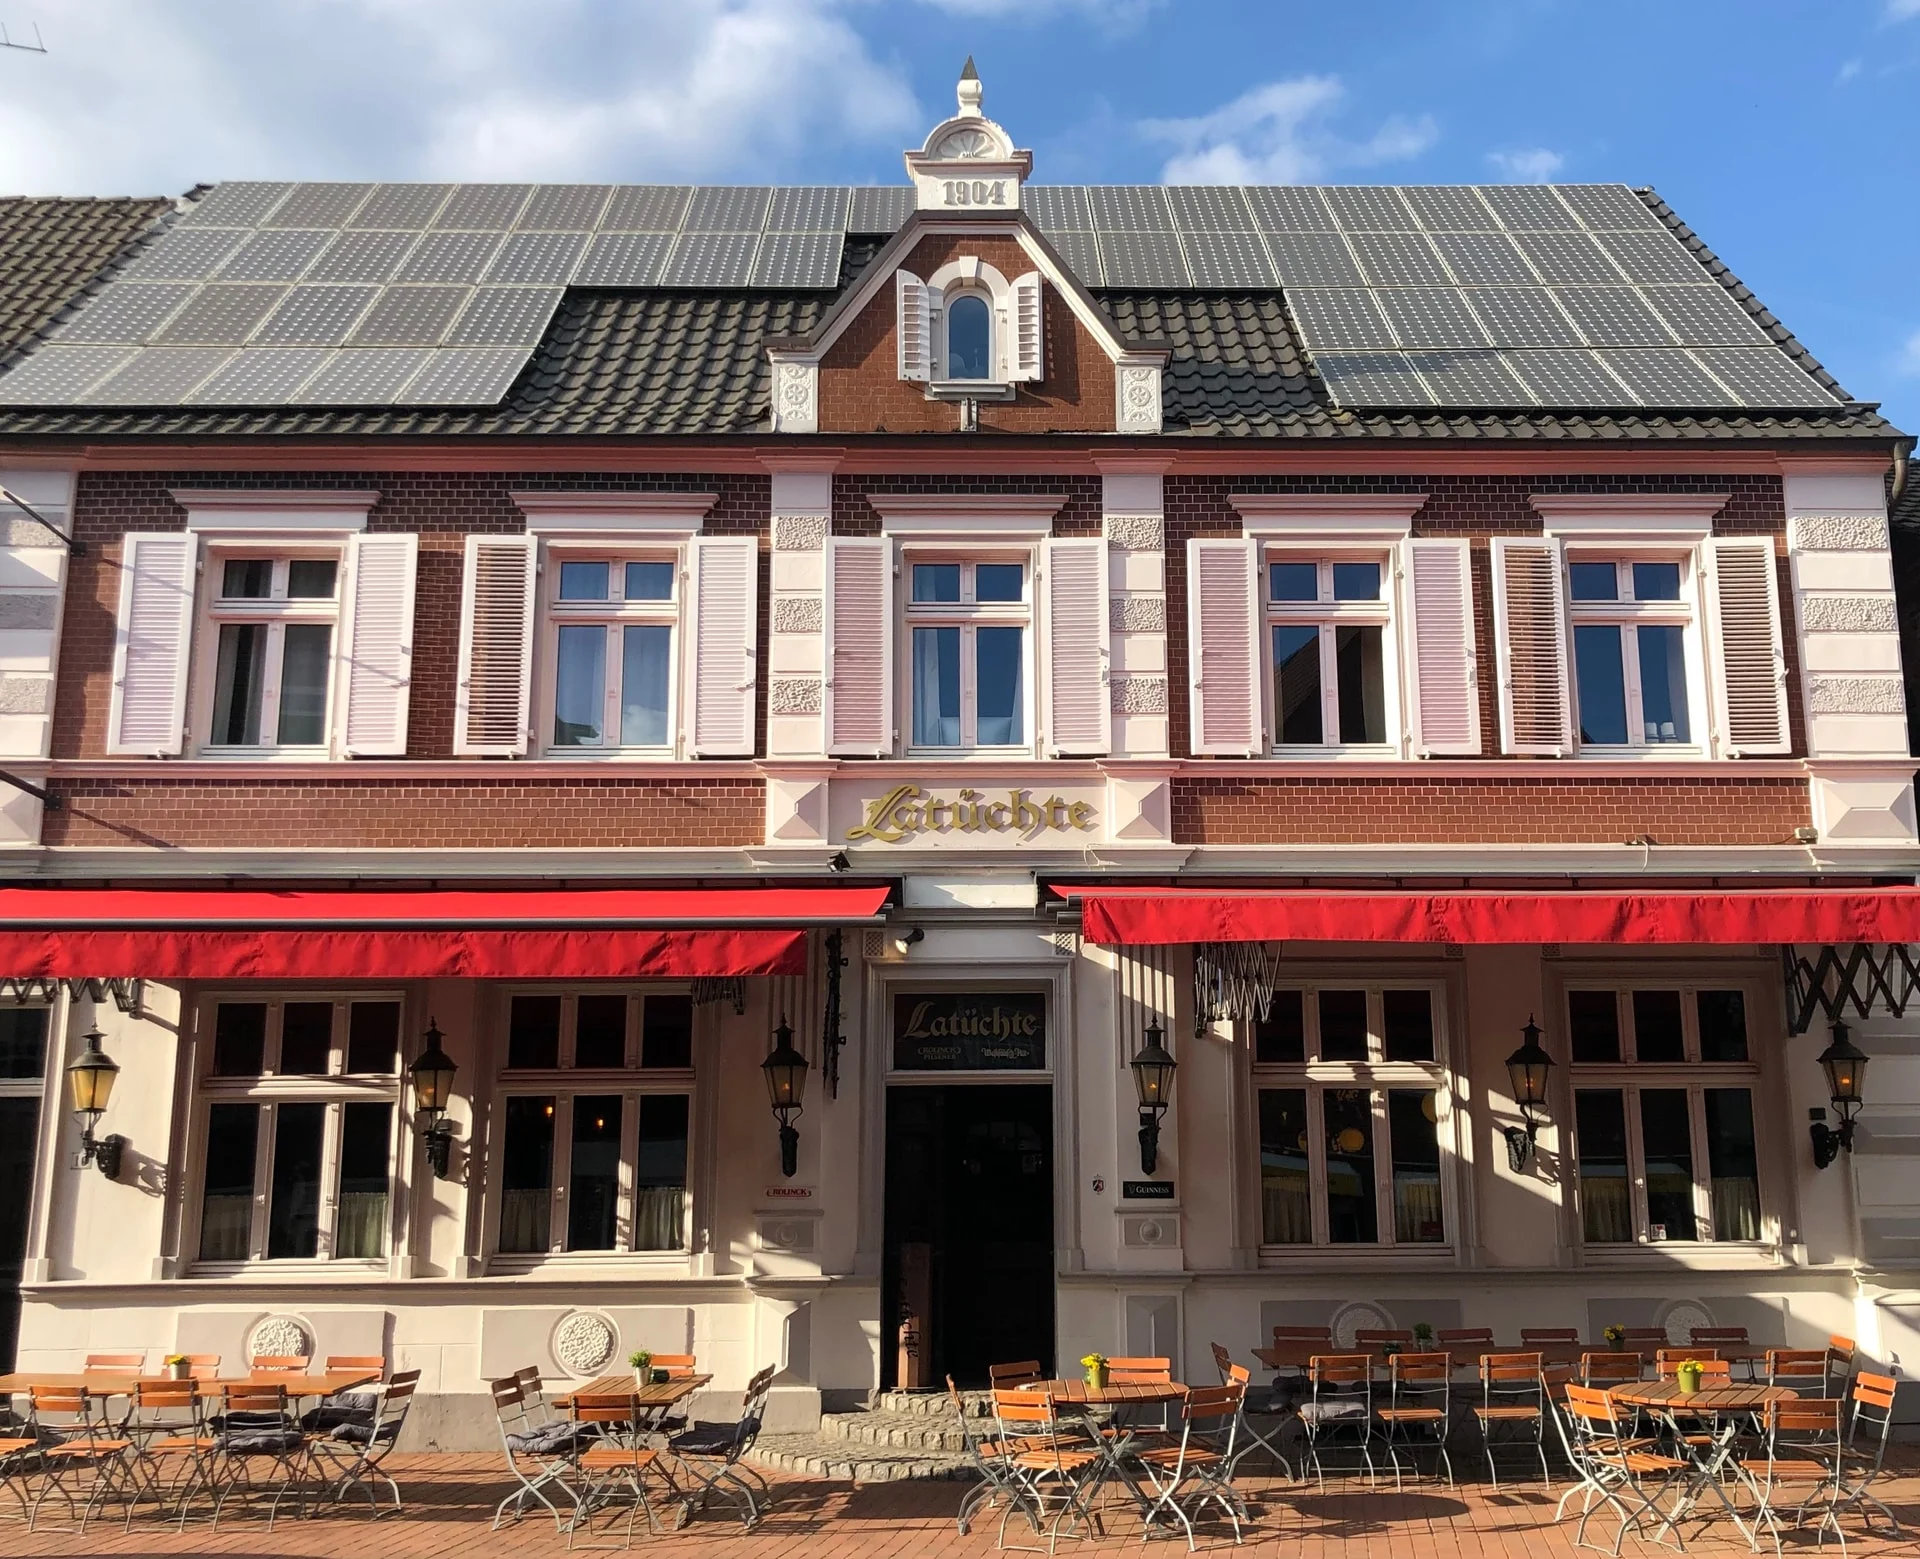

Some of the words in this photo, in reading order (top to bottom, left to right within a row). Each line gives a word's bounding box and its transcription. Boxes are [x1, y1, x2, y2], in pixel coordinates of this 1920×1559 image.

[942, 181, 1006, 205] 1904
[845, 783, 1091, 841] Latüchte
[903, 1000, 1041, 1041] Latüchte
[1135, 1185, 1169, 1194] GUINNESS
